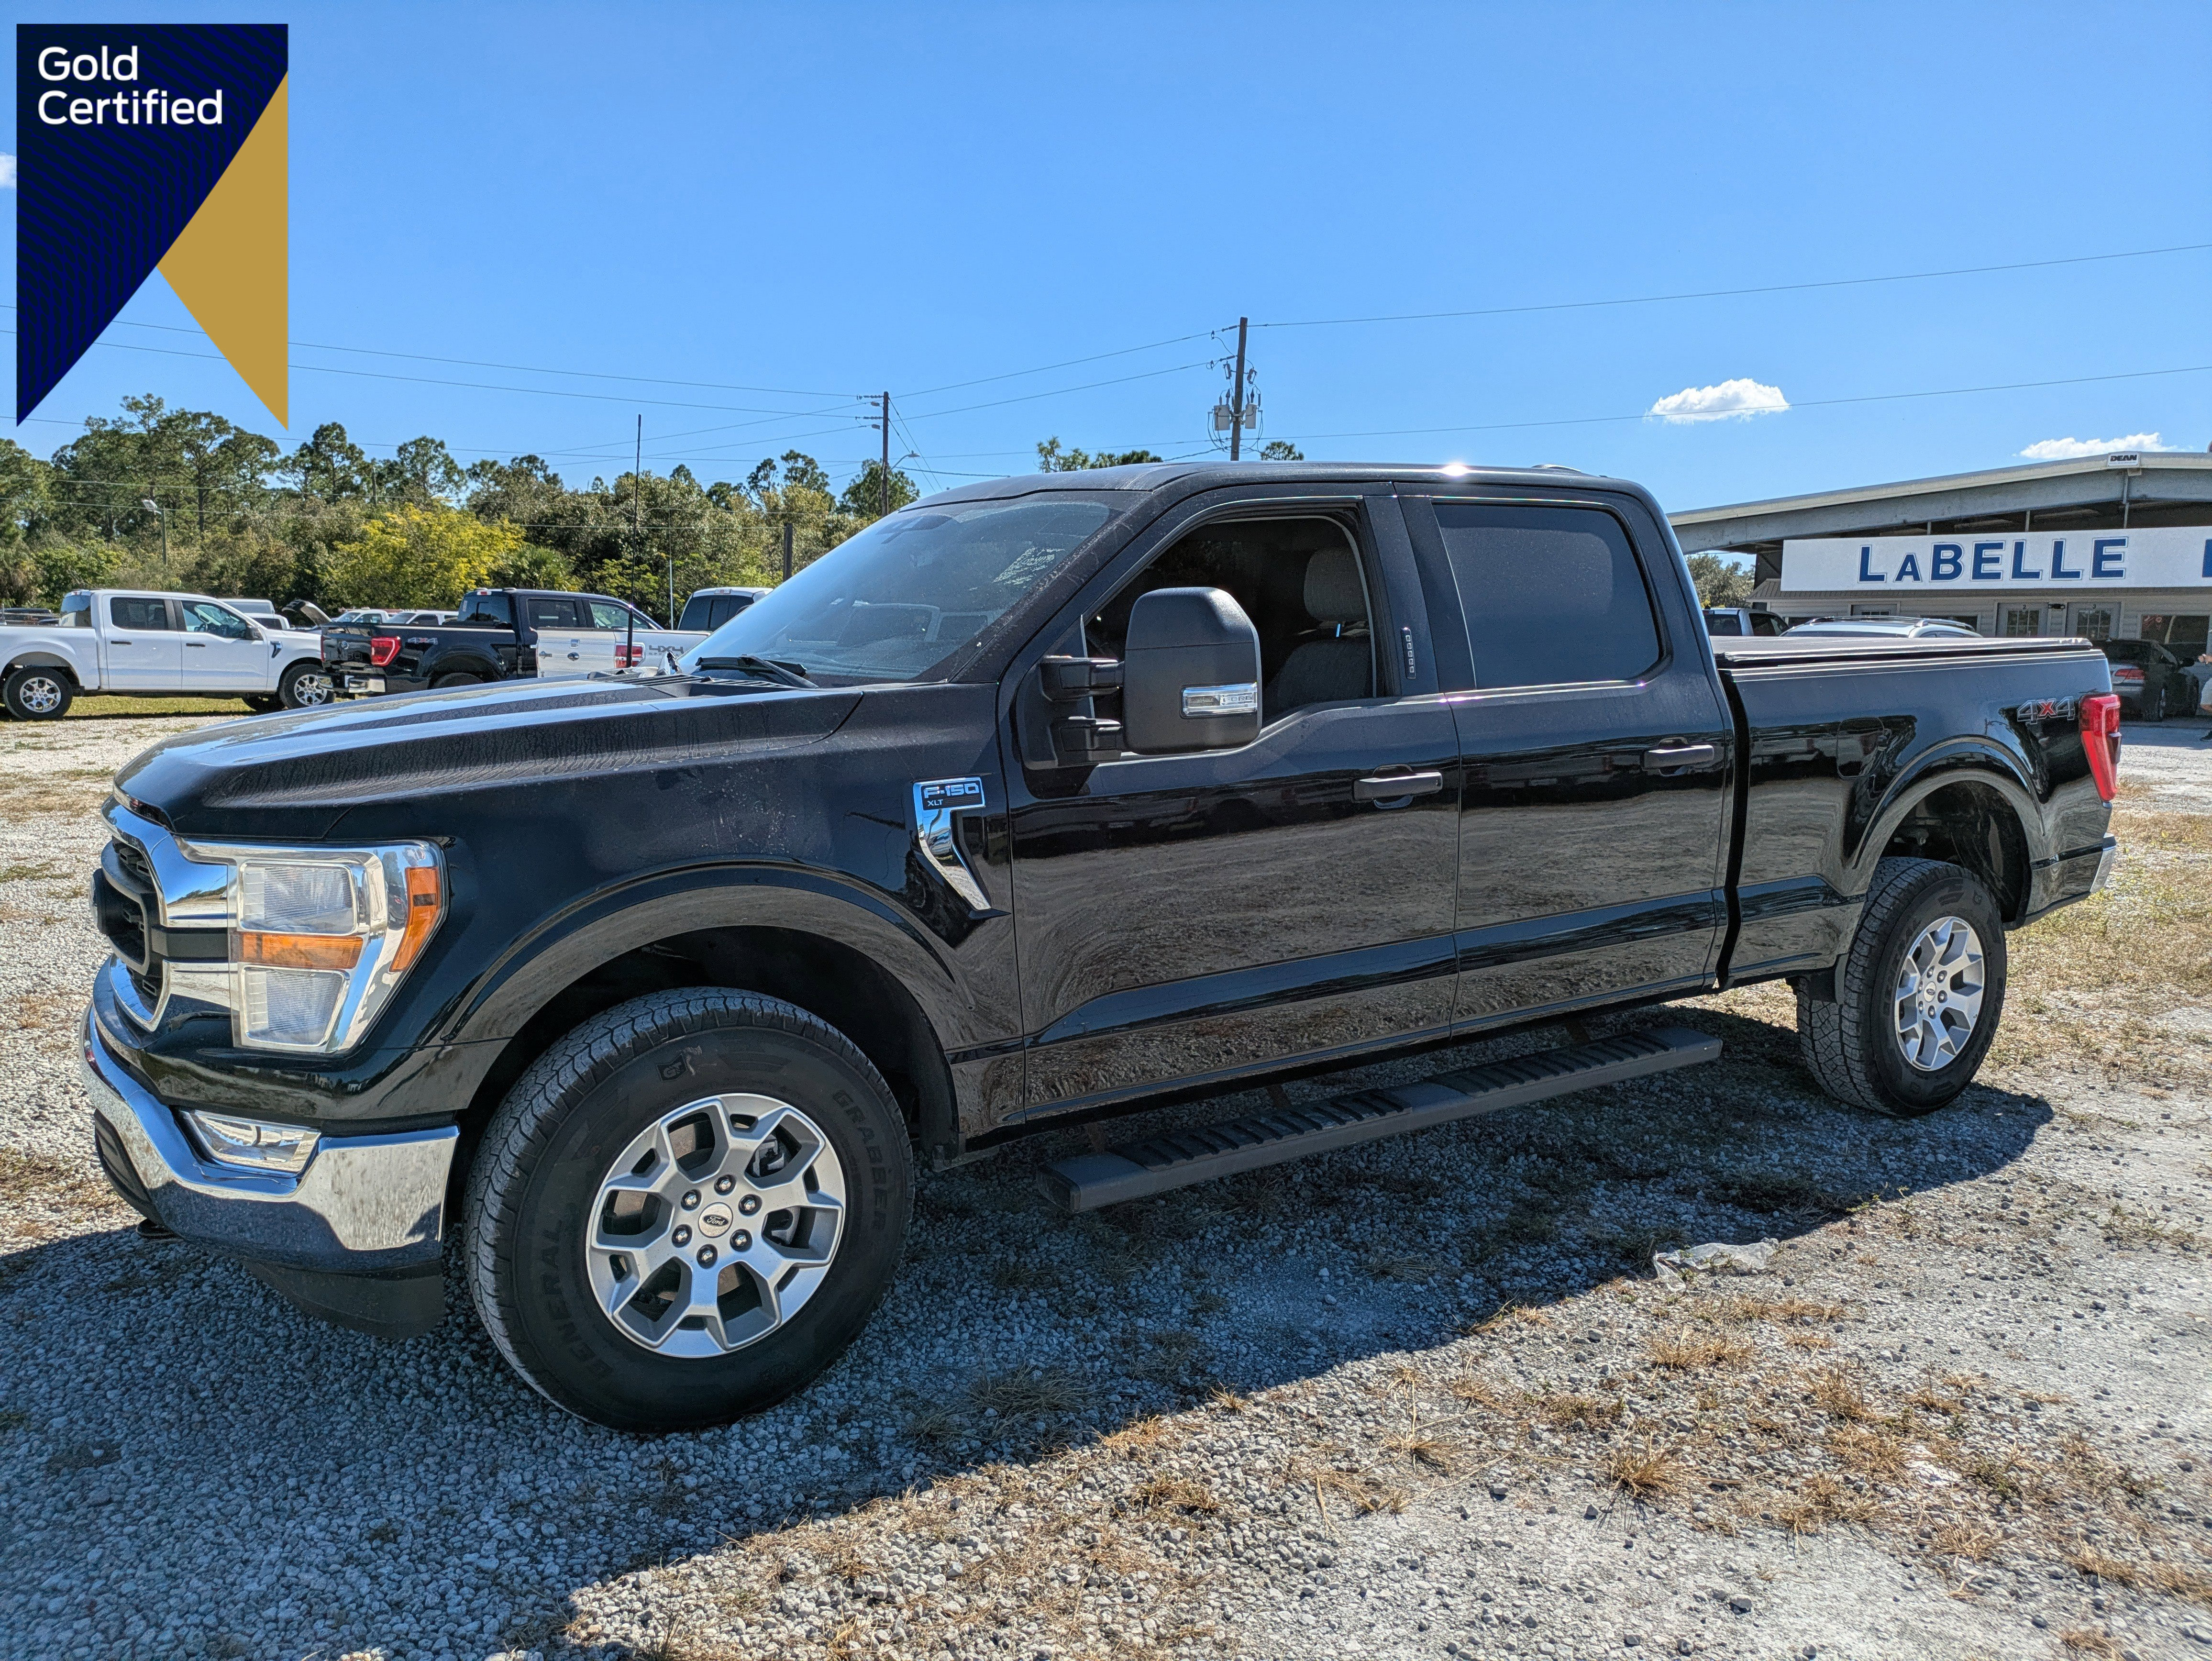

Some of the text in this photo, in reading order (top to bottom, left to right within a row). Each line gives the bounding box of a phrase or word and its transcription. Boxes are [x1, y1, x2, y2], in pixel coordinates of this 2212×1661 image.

[923, 783, 980, 798] F-150
[831, 1089, 890, 1231] GRABBER
[707, 1216, 725, 1225] Ford
[542, 1220, 614, 1379] GENERAL
